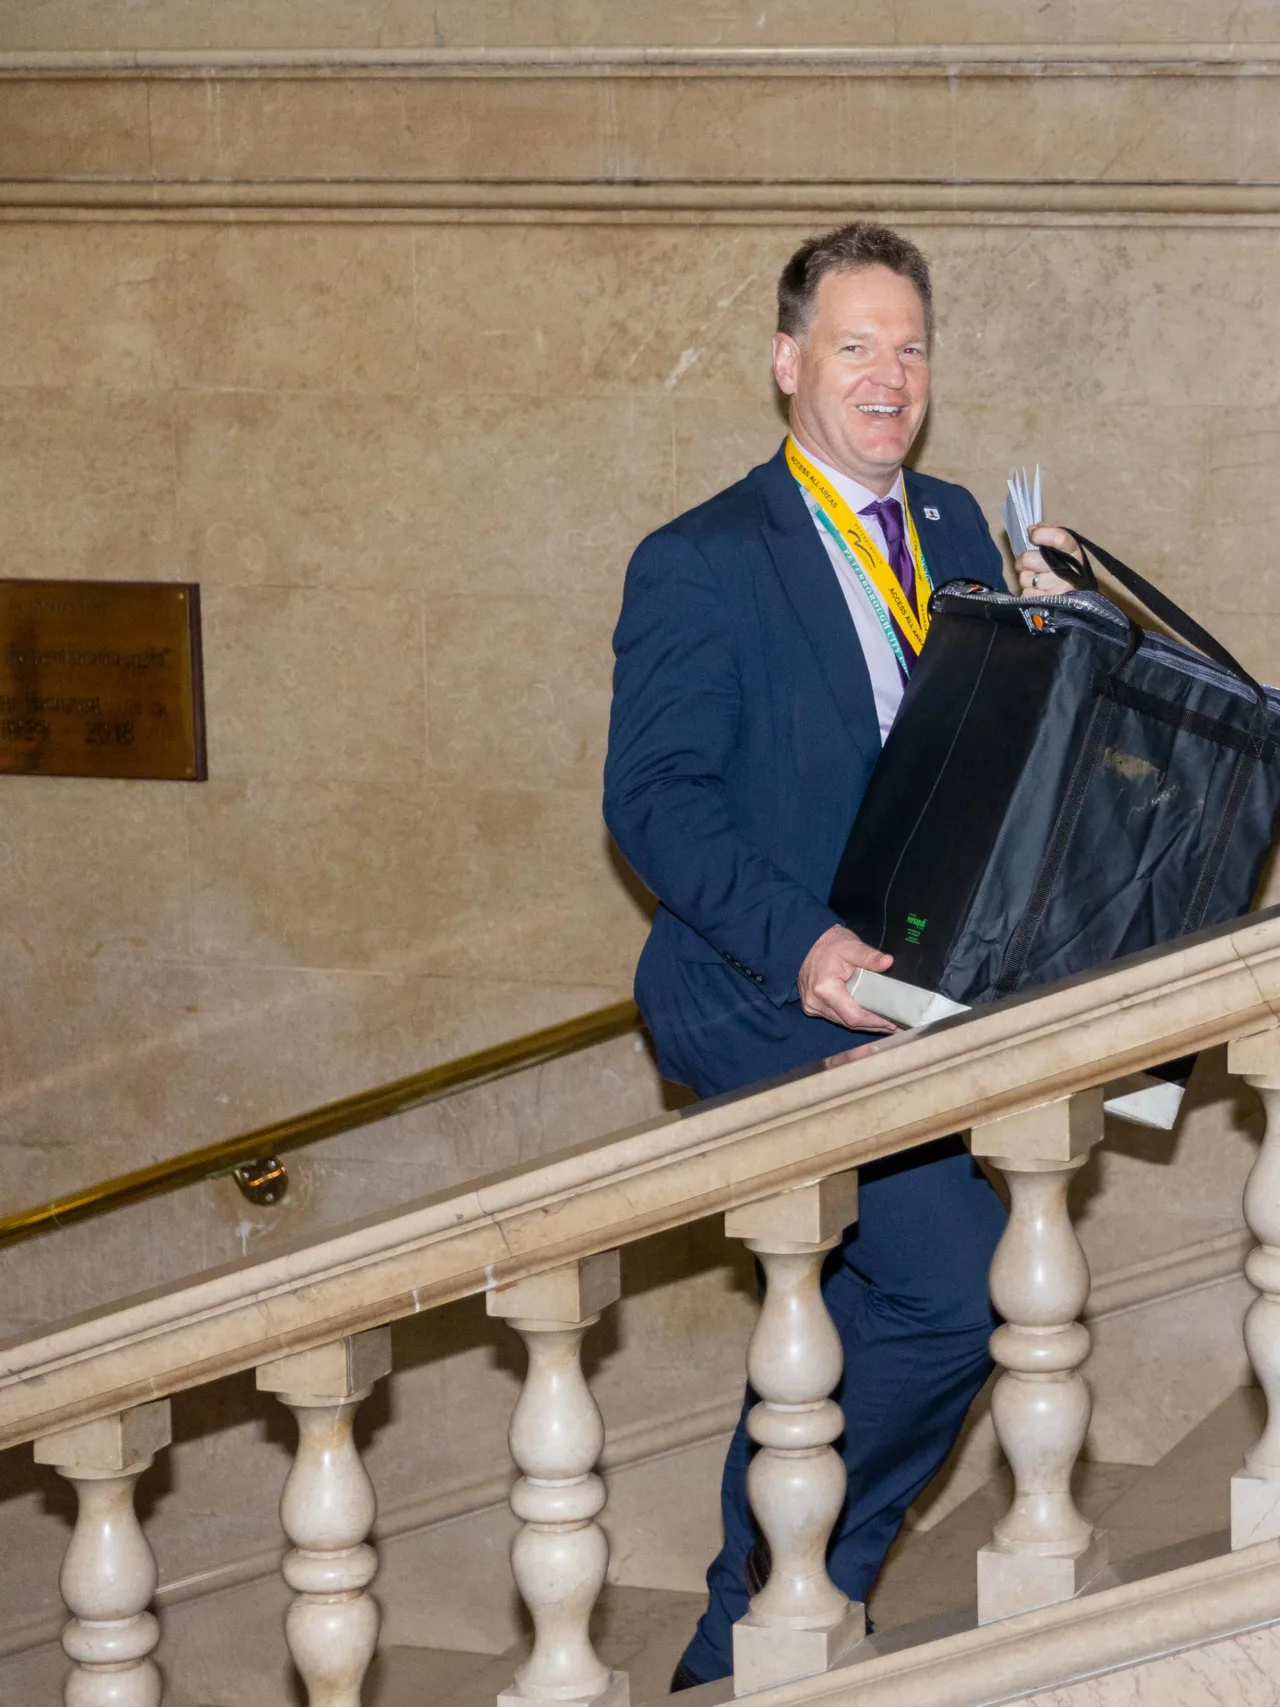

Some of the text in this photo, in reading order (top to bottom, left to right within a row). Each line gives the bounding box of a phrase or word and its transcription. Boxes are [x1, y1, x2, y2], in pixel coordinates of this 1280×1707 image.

[791, 456, 839, 509] ACCESS ALL AREAS
[843, 549, 891, 630] PETERBOROUGH
[887, 631, 902, 653] CITY
[889, 588, 907, 616] ACCESS
[906, 615, 915, 629] ALL
